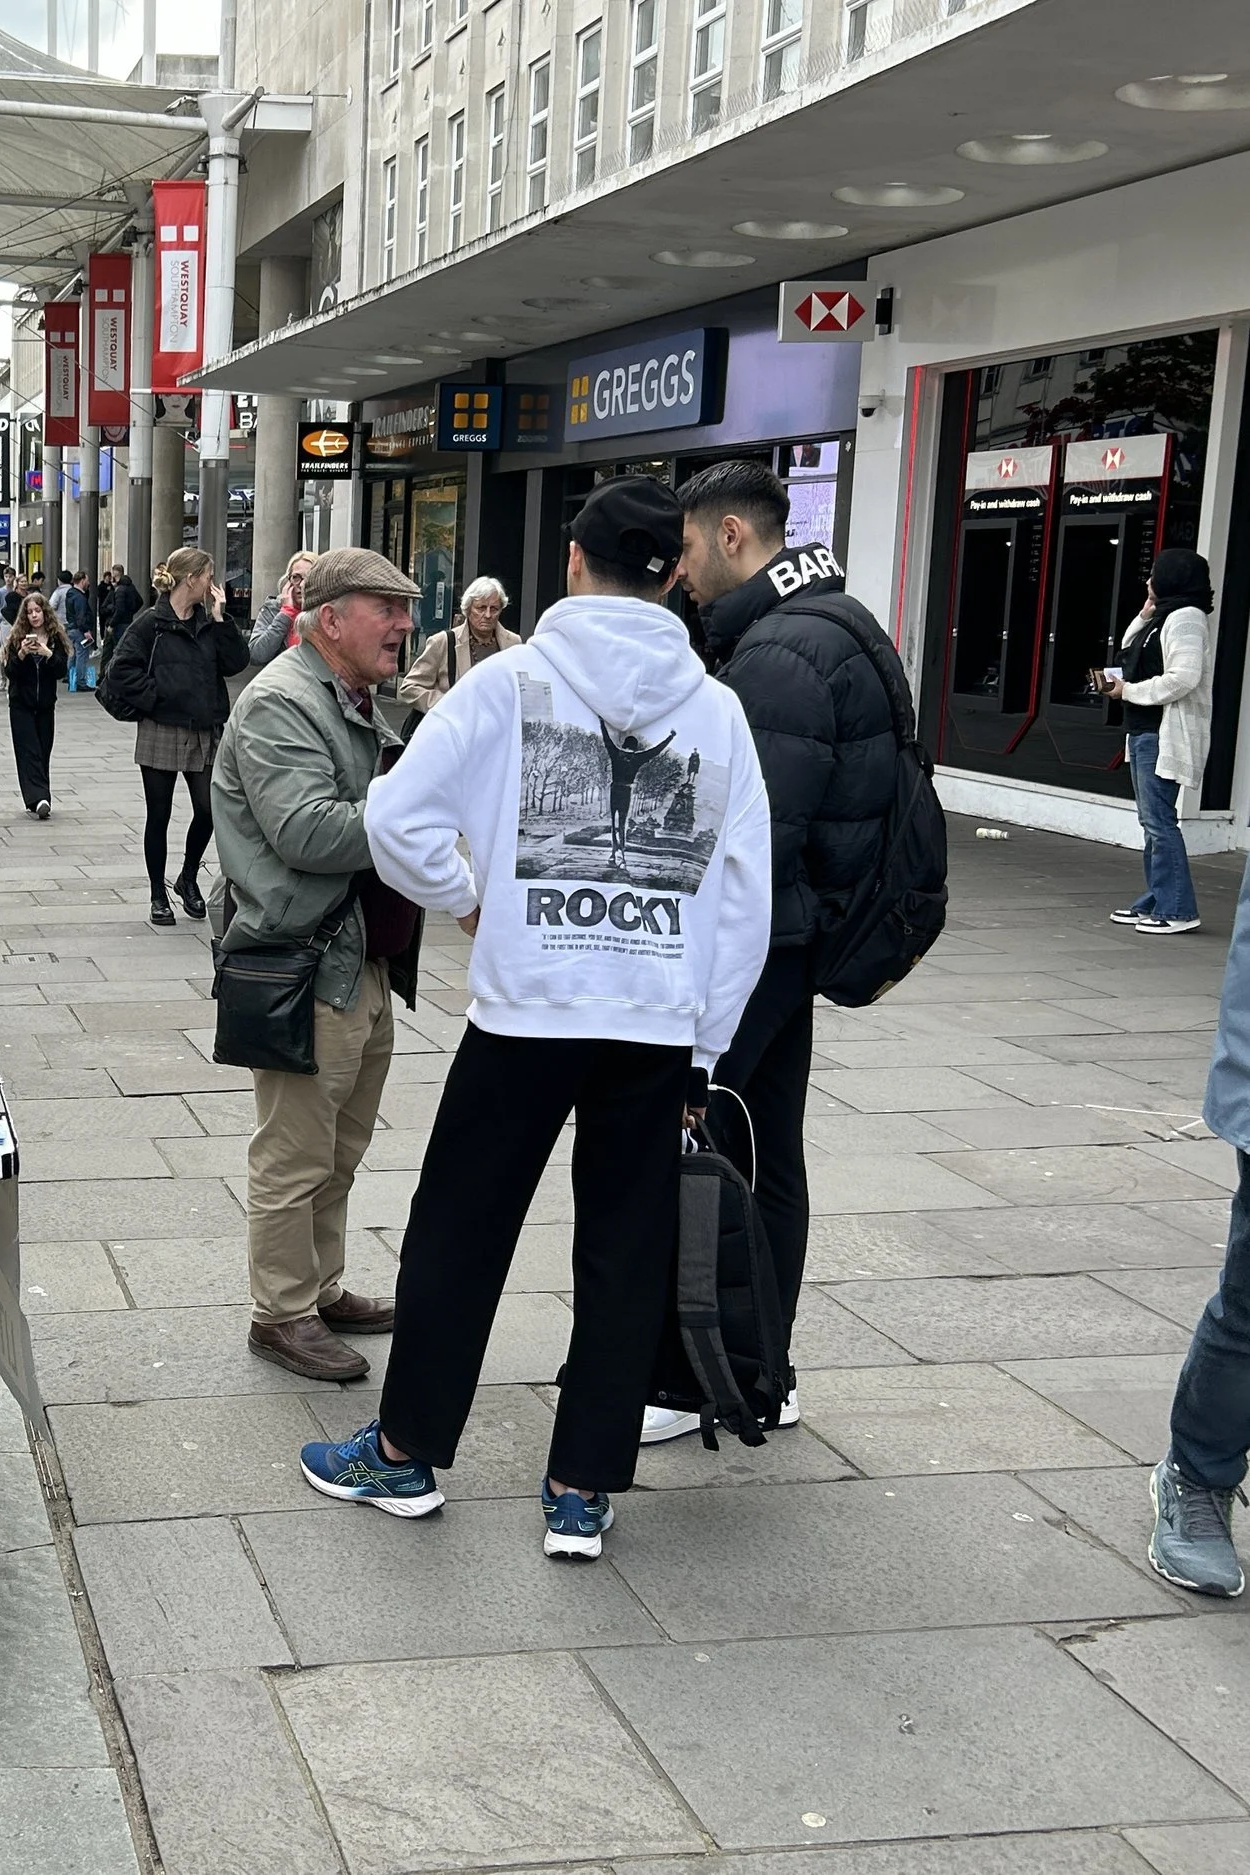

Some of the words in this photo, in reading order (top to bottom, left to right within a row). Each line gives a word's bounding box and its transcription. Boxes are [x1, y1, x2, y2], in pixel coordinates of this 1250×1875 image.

[170, 260, 180, 345] SOUTHAMPTON
[180, 260, 190, 328] WESTQUAY
[109, 316, 118, 371] WESTQUAY
[62, 355, 70, 401] WESTQUAY
[593, 349, 696, 420] GREGGS
[371, 405, 430, 438] TRAILFINDERS
[452, 434, 488, 443] GREGGS
[969, 500, 986, 511] Pay-in
[987, 499, 998, 509] and
[998, 498, 1026, 509] withdraw
[1026, 497, 1041, 508] cash
[1069, 494, 1089, 507] Pay-in
[1089, 493, 1102, 504] and
[1102, 491, 1135, 503] withdraw
[1135, 490, 1152, 502] cash
[525, 887, 682, 935] ROCKY
